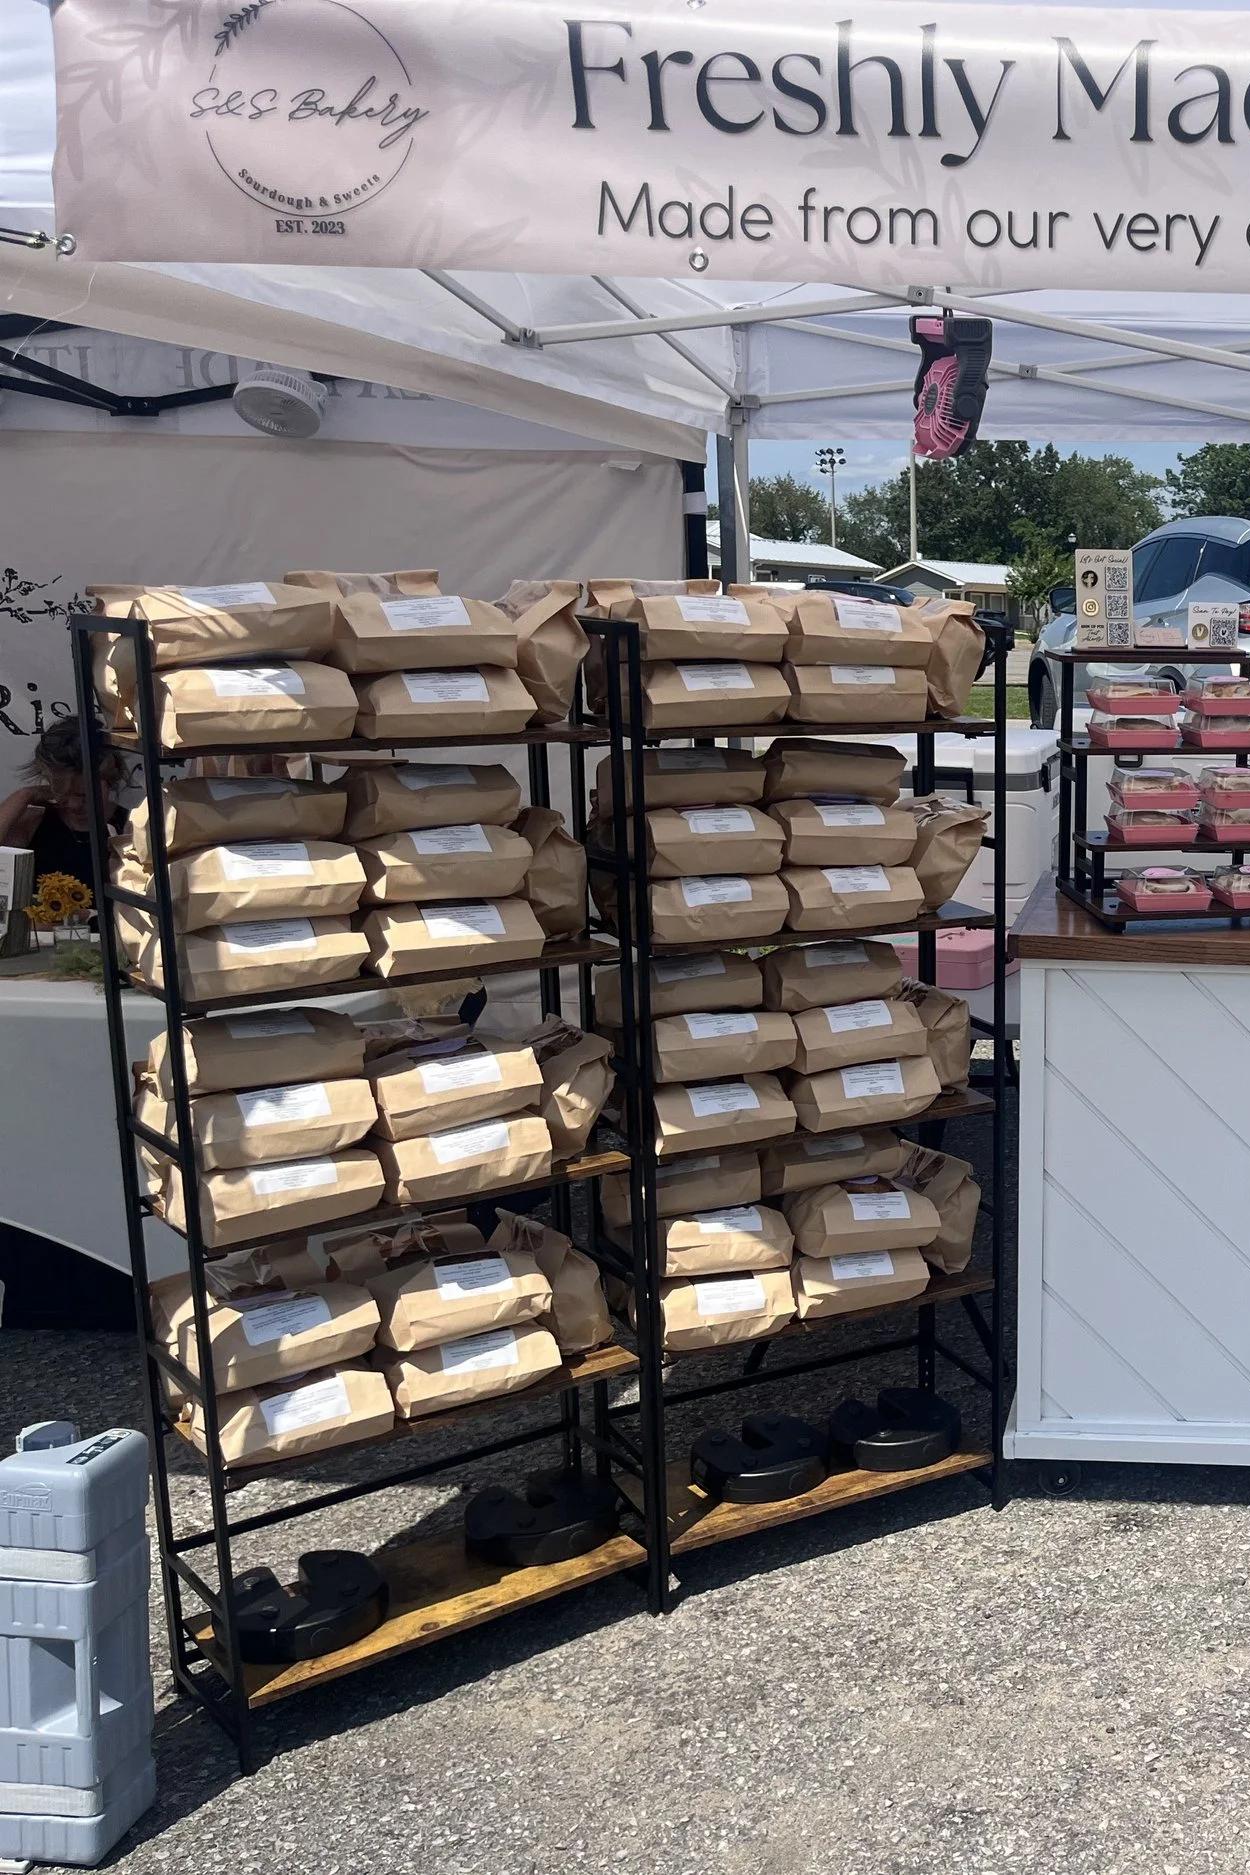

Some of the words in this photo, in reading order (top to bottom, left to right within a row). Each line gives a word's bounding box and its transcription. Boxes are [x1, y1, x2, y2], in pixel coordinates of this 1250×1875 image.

[189, 87, 278, 120] S&S
[288, 75, 430, 149] Bakery
[563, 19, 1017, 168] Freshly
[238, 168, 313, 210] Sourdough
[318, 196, 329, 208] &
[334, 173, 381, 205] Sweets
[597, 180, 775, 243] Made
[797, 186, 939, 247] from
[966, 209, 1071, 250] our
[1092, 212, 1221, 267] very
[275, 219, 308, 235] EST.
[311, 220, 346, 235] 2023
